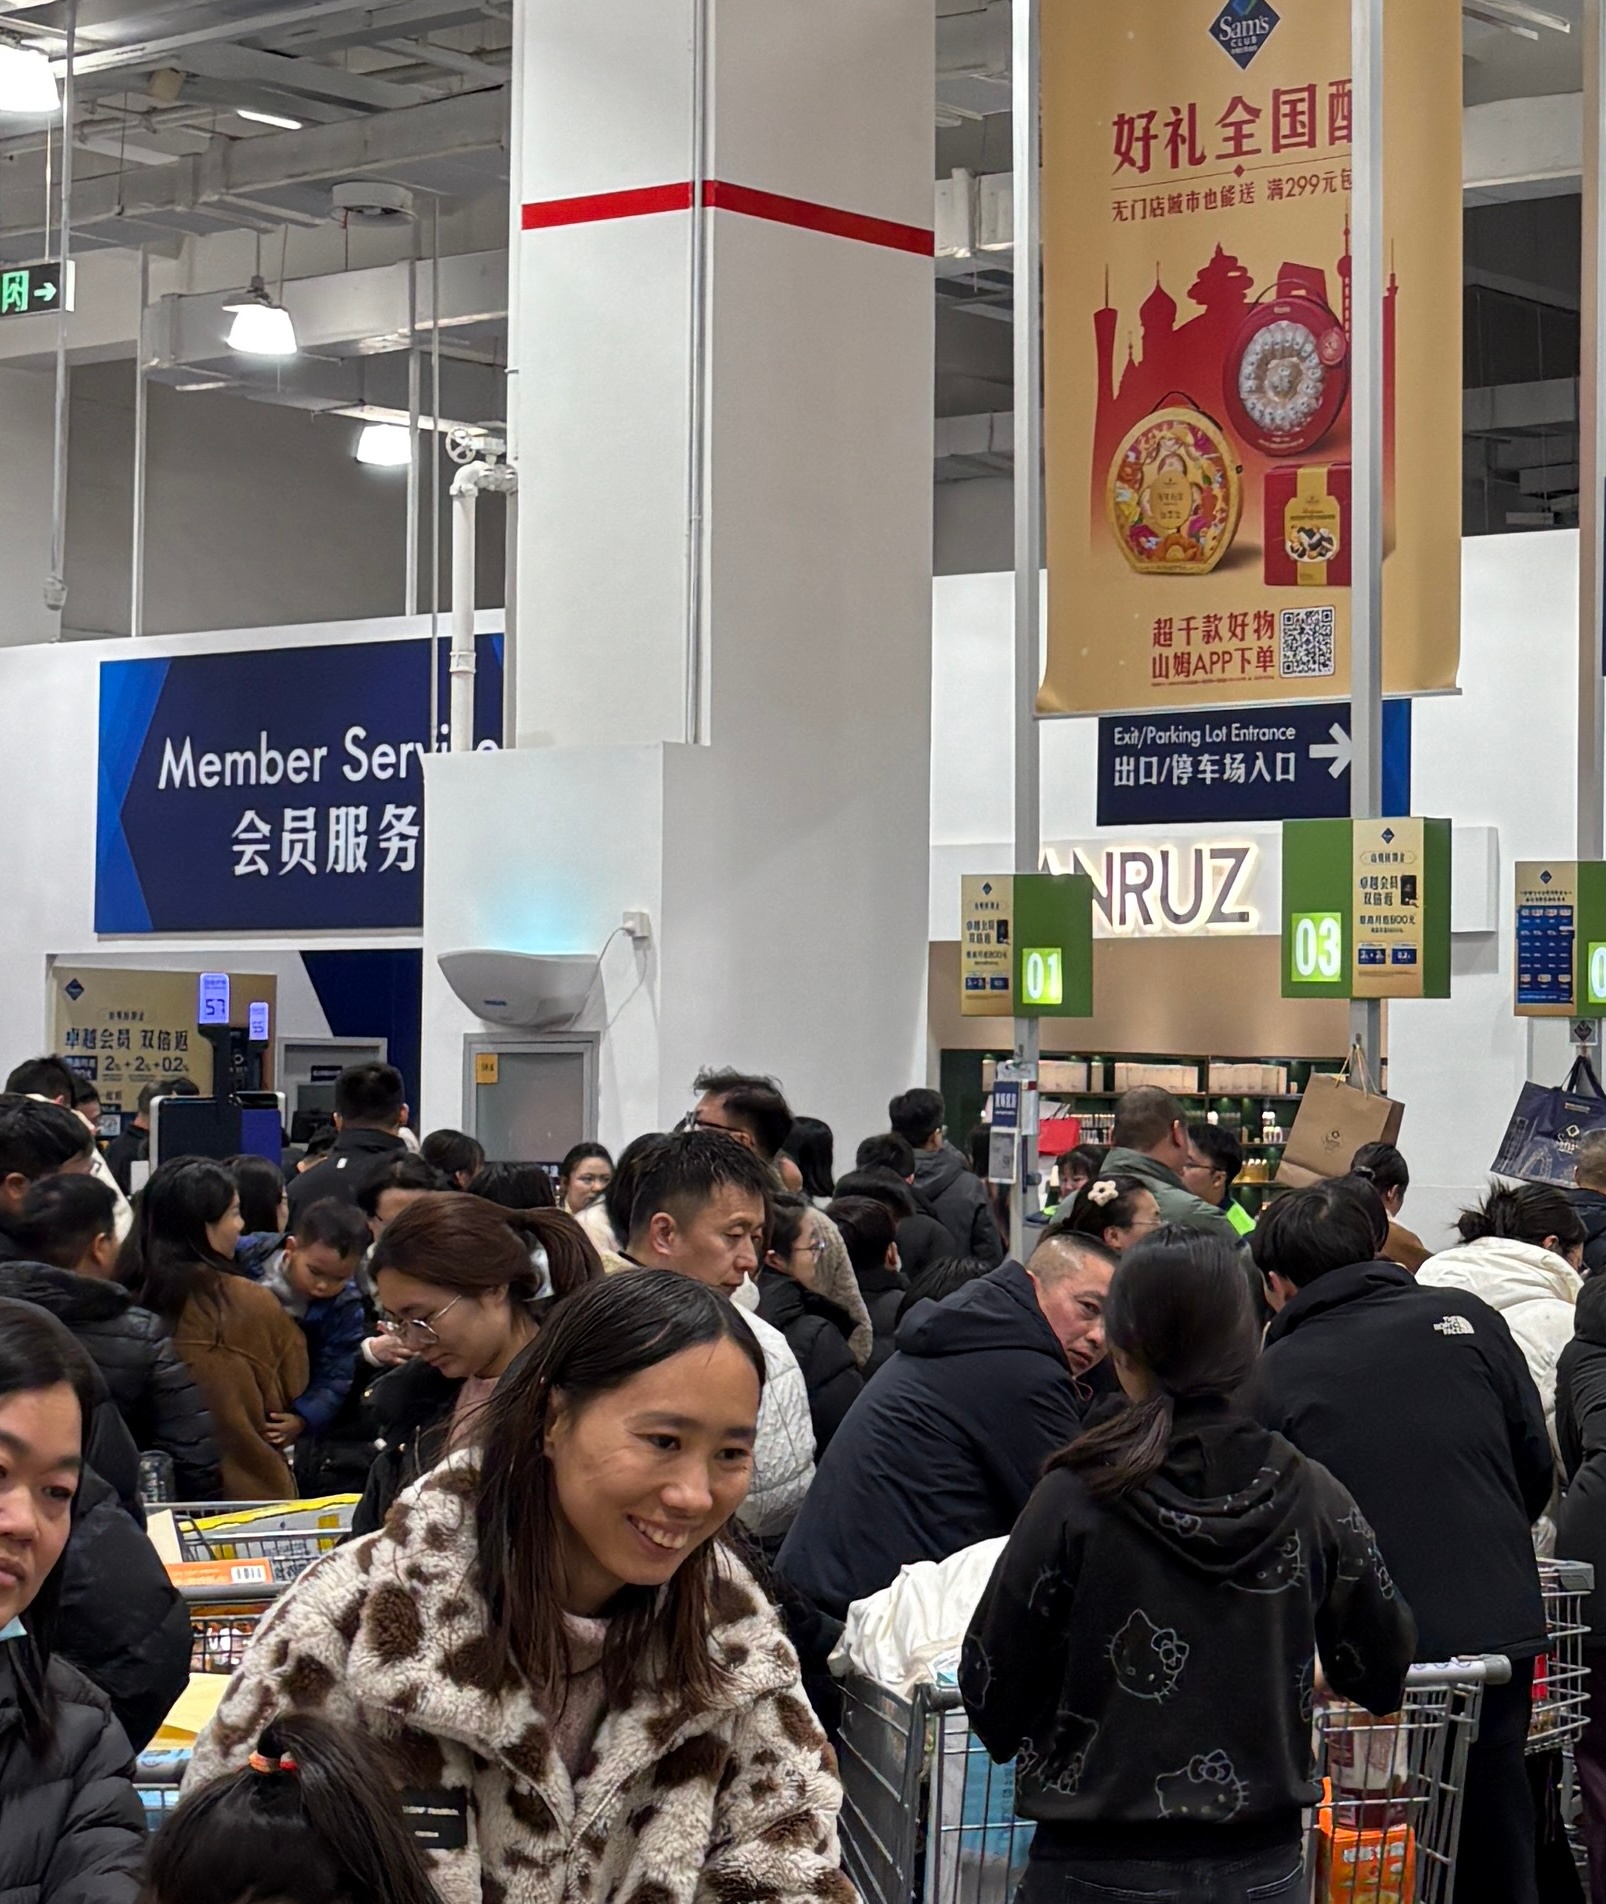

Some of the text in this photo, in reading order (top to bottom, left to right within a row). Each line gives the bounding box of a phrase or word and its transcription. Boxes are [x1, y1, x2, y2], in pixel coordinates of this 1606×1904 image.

[1219, 15, 1270, 41] Sam's
[1152, 610, 1275, 648] 超千款好物
[1151, 645, 1275, 680] 山姆APP下单
[1114, 723, 1297, 749] Exit/Parking Lot Entrance
[158, 731, 328, 790] Member
[1113, 751, 1296, 787] 出口/停车场入口
[231, 804, 421, 876] 会员服务
[1295, 917, 1340, 977] 03
[1027, 952, 1058, 999] 01
[205, 998, 226, 1016] 57
